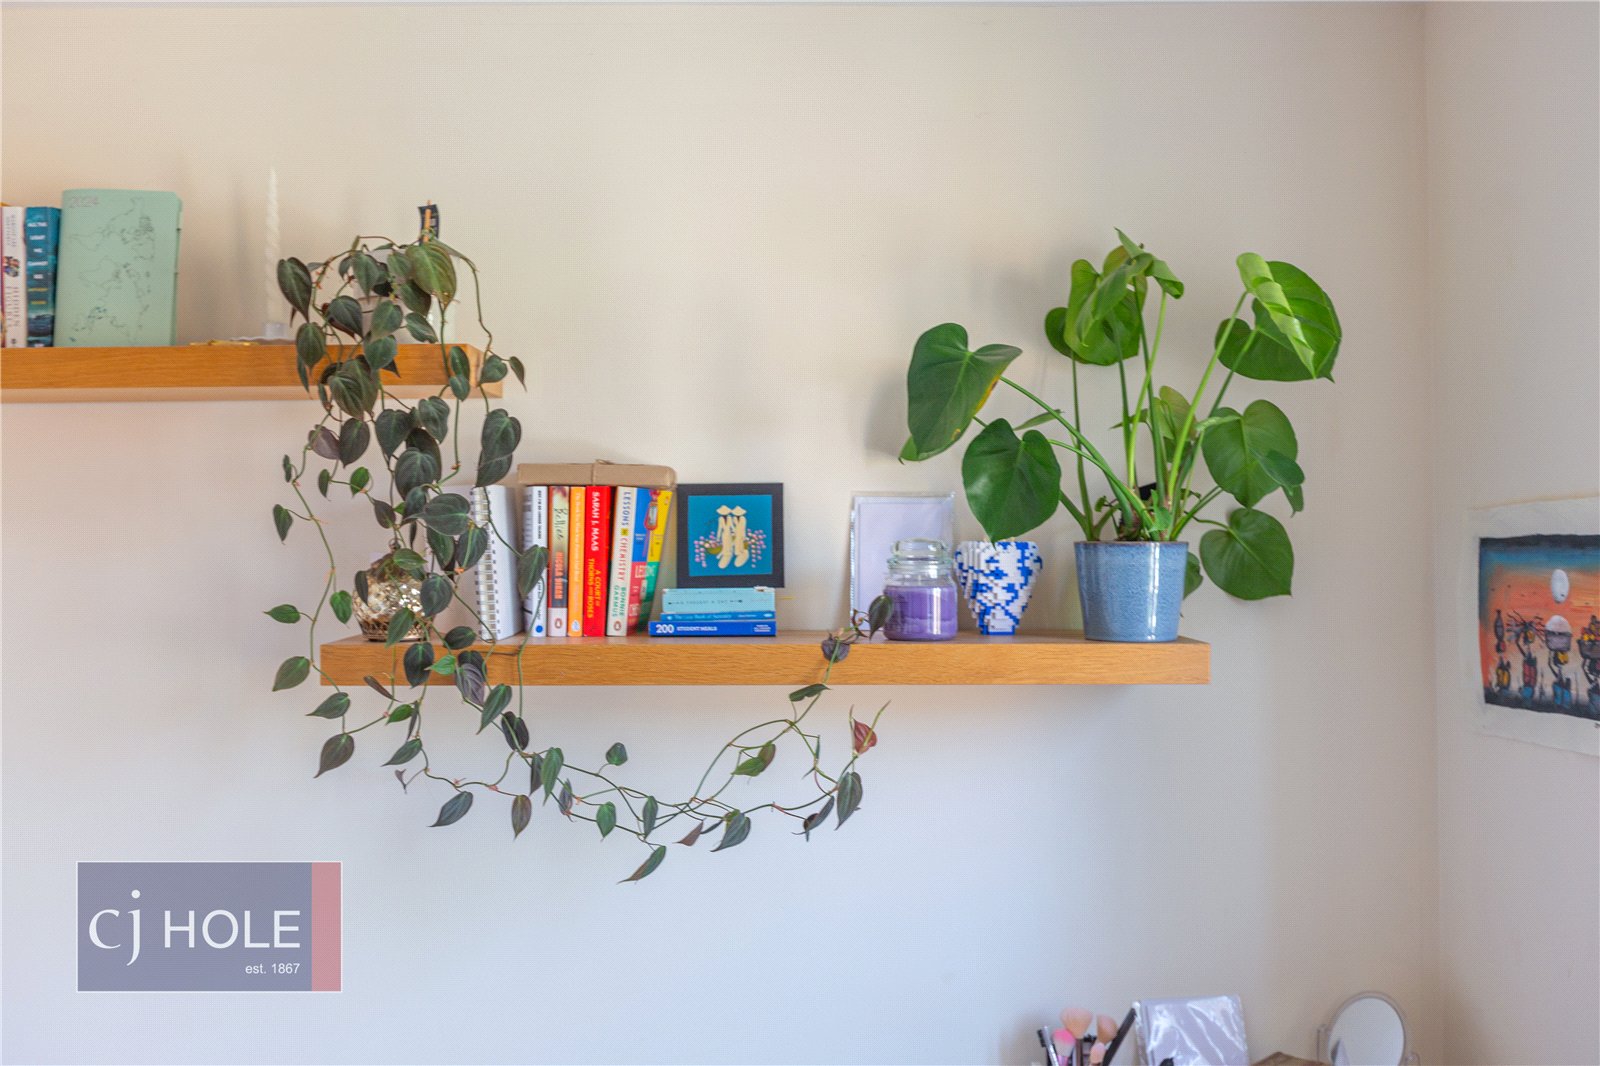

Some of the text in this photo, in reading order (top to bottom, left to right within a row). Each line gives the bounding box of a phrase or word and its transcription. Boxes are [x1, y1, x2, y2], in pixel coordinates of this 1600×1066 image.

[592, 491, 600, 519] SARAH
[621, 491, 631, 526] LESSONS
[591, 527, 599, 552] MAAS
[617, 537, 628, 581] CHEMISTRY
[612, 585, 620, 618] GARMUS
[656, 624, 674, 633] 200
